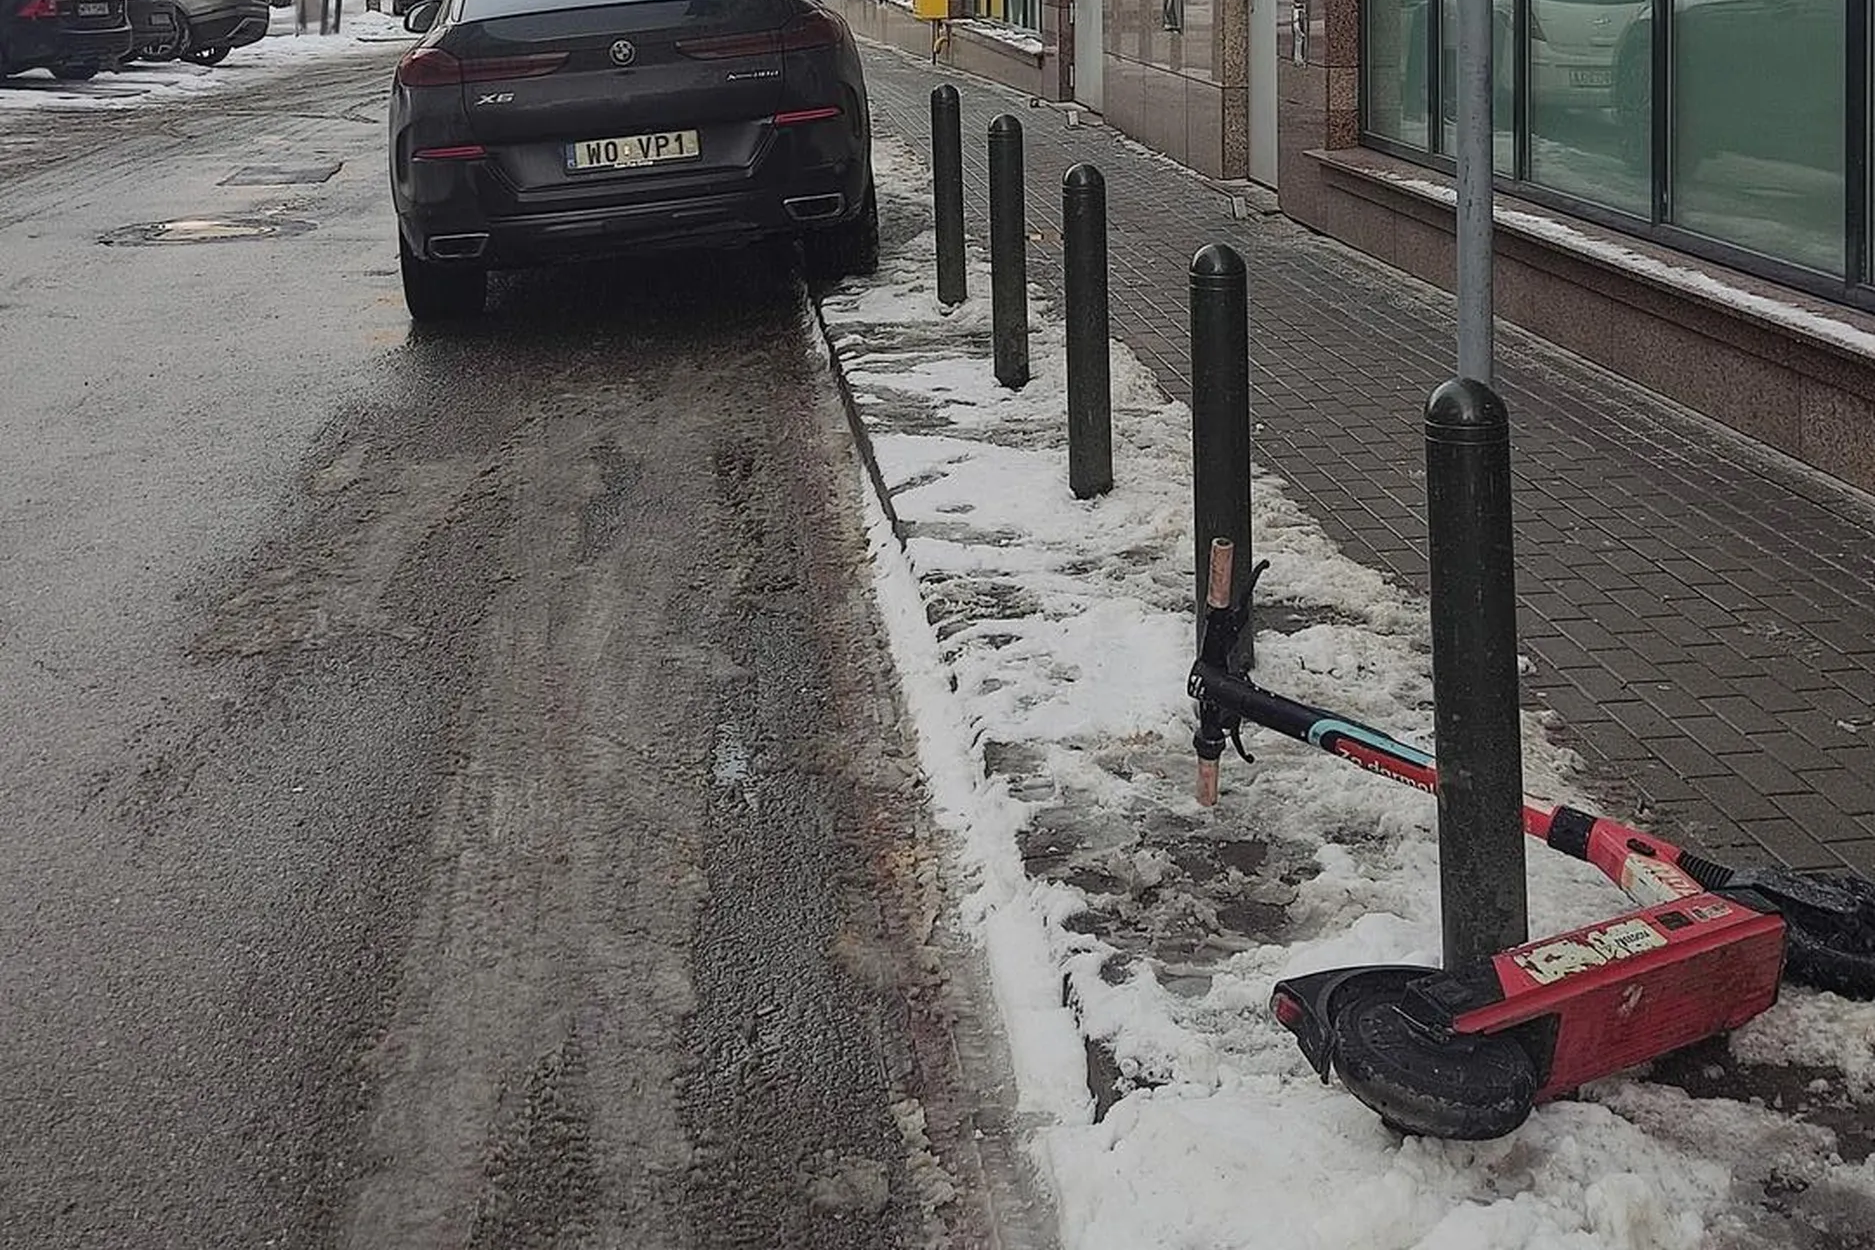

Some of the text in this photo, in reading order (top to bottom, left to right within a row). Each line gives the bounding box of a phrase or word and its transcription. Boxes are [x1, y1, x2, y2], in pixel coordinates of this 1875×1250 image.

[476, 93, 515, 105] X6
[586, 134, 684, 165] WO VP1
